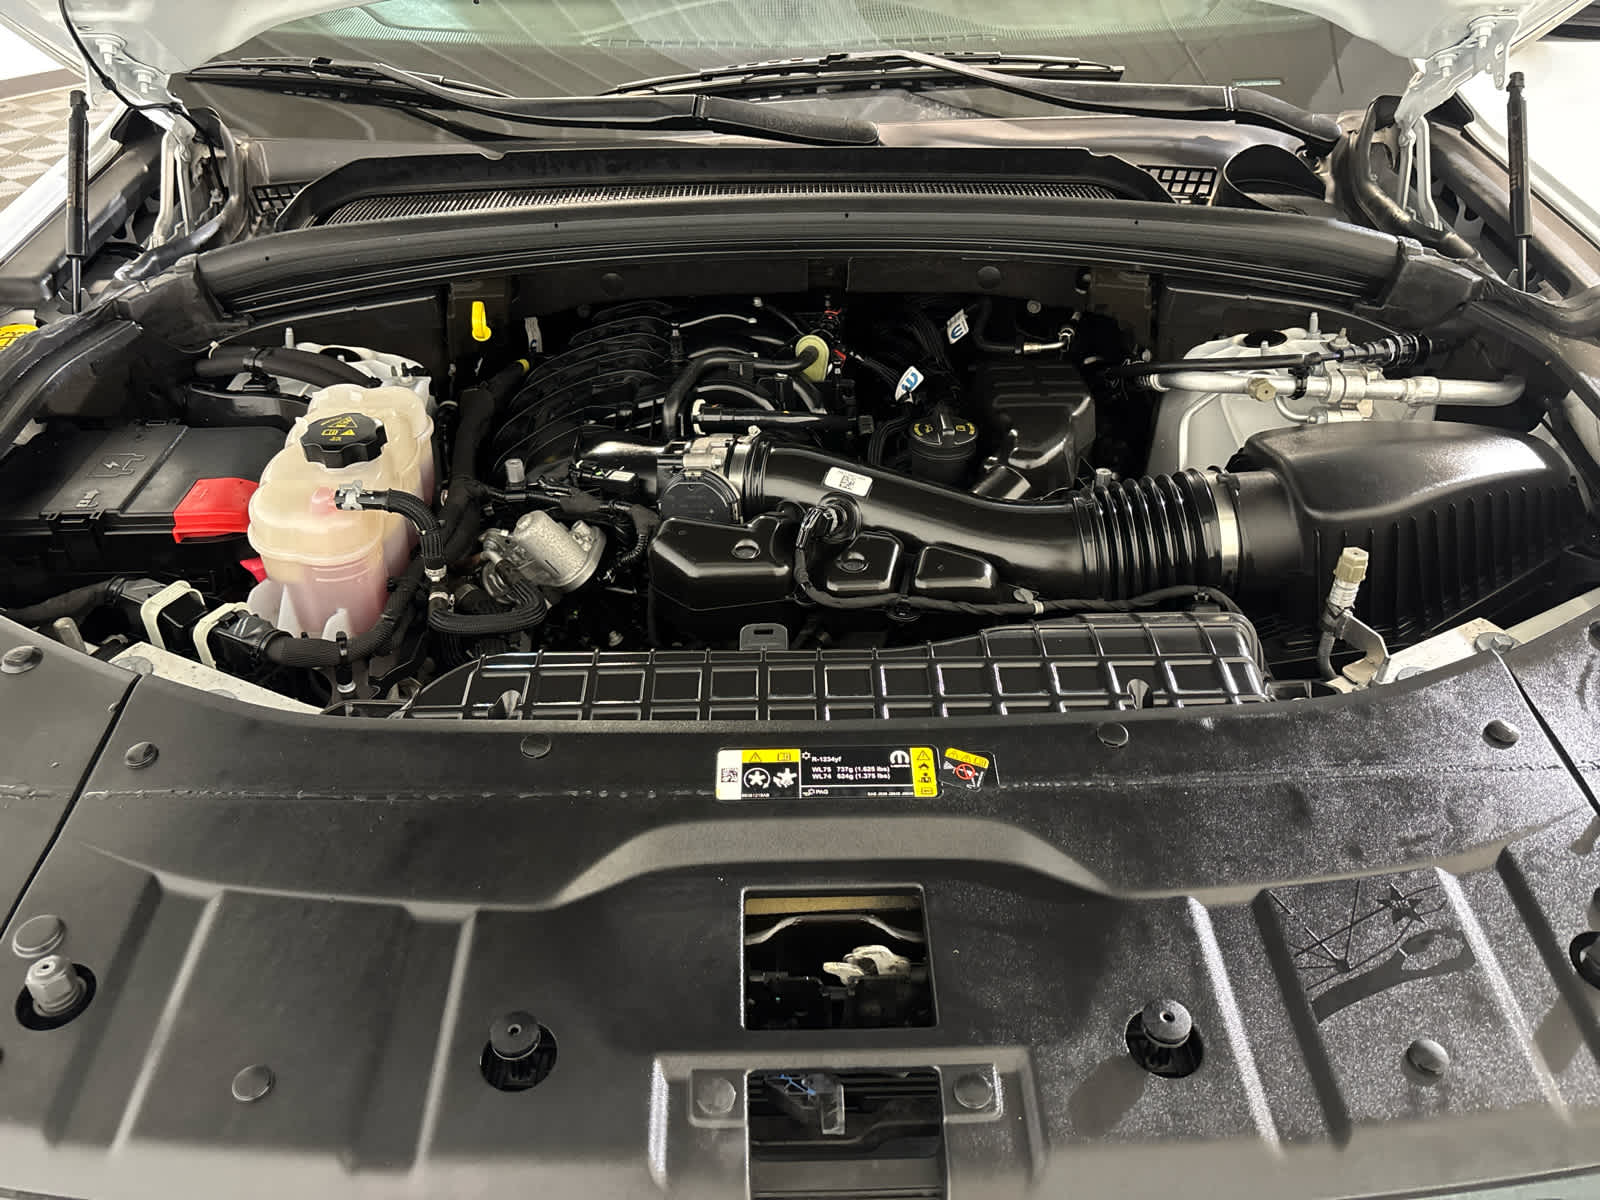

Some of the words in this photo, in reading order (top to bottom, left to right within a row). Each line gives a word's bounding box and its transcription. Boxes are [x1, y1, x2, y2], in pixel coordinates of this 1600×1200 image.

[811, 756, 842, 764] R-1234yf
[836, 766, 854, 774] 737g
[876, 766, 890, 774] lbs)
